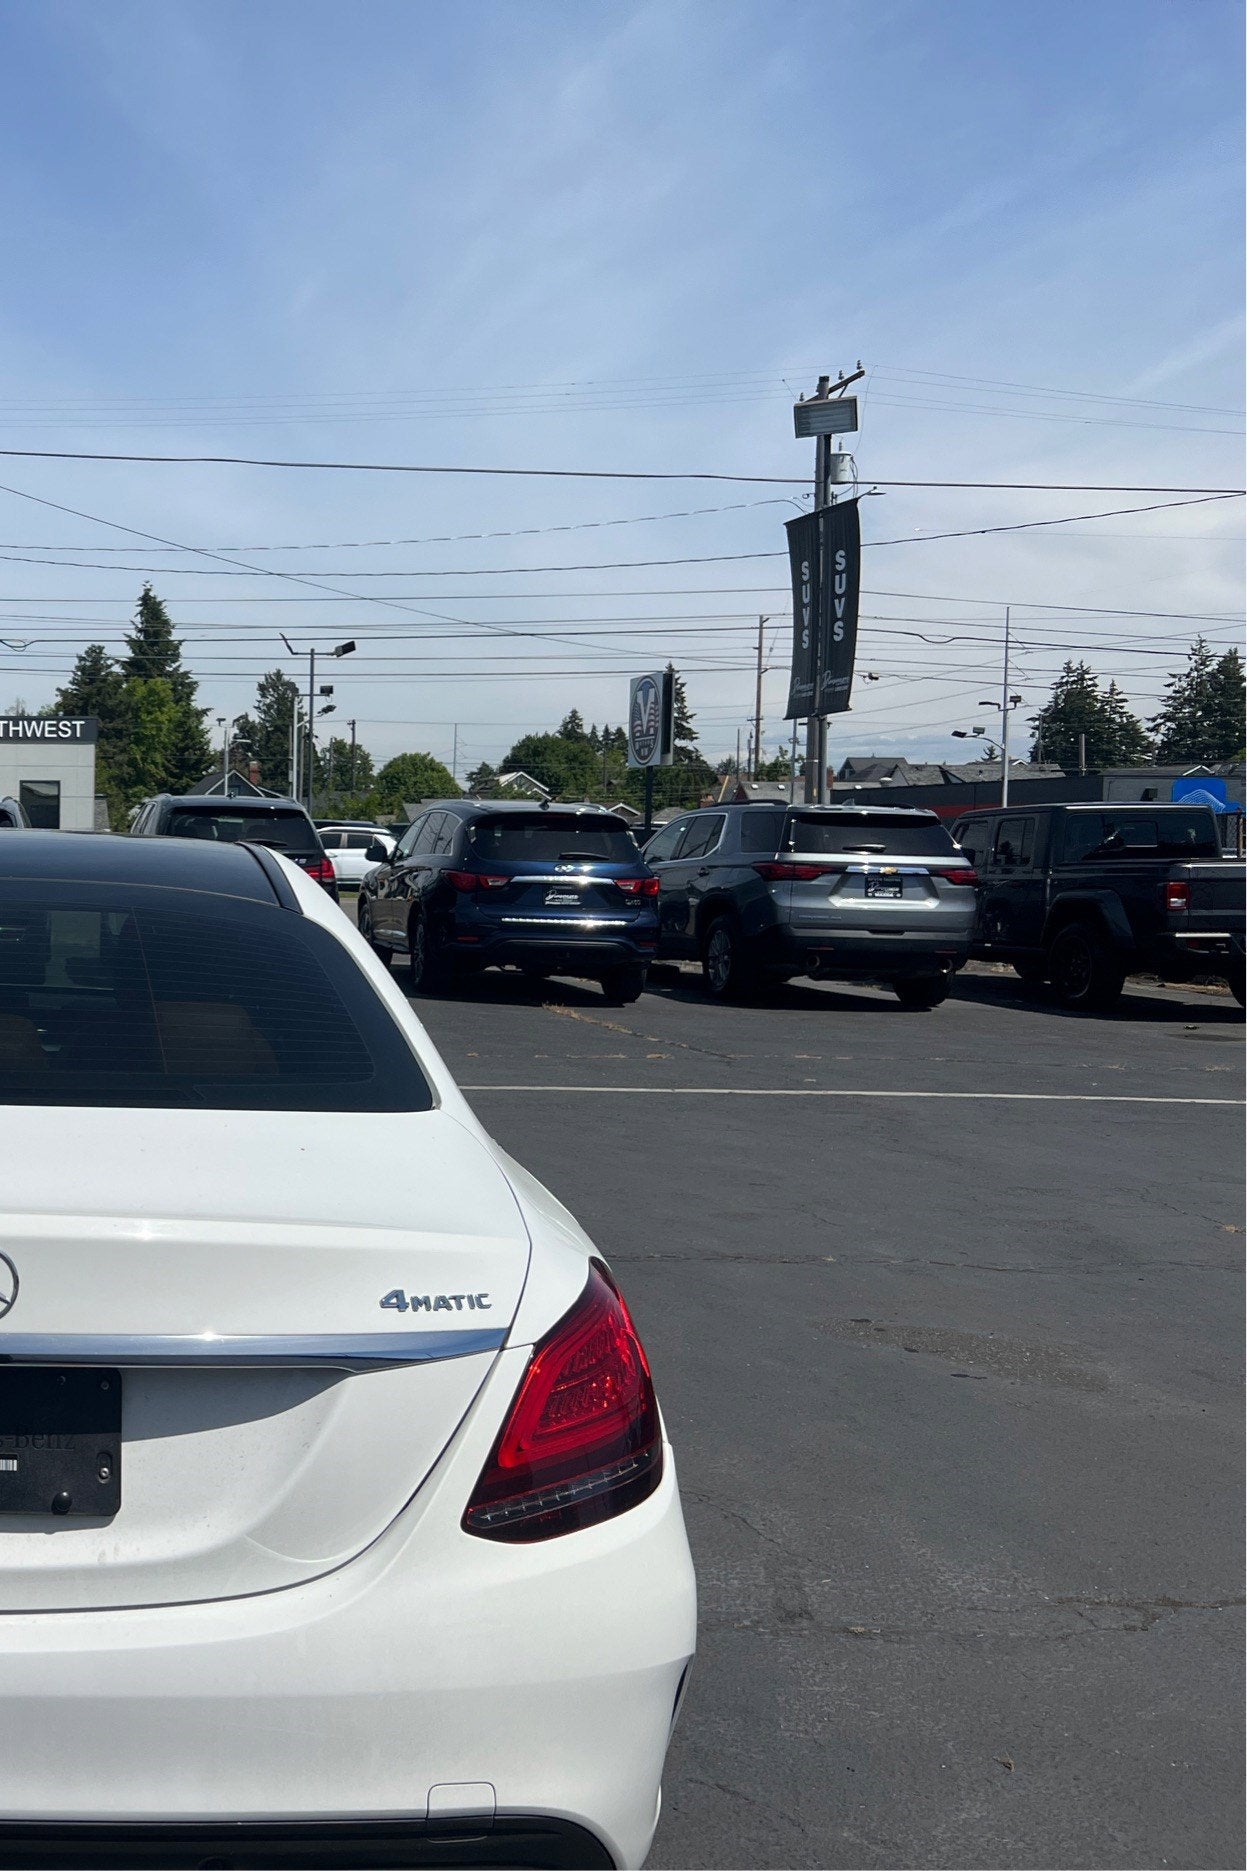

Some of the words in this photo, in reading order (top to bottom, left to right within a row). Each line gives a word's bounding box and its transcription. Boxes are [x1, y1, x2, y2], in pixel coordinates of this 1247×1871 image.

[801, 561, 810, 650] SUVS
[832, 549, 846, 642] SUVS
[379, 1289, 493, 1312] 4MATIC
